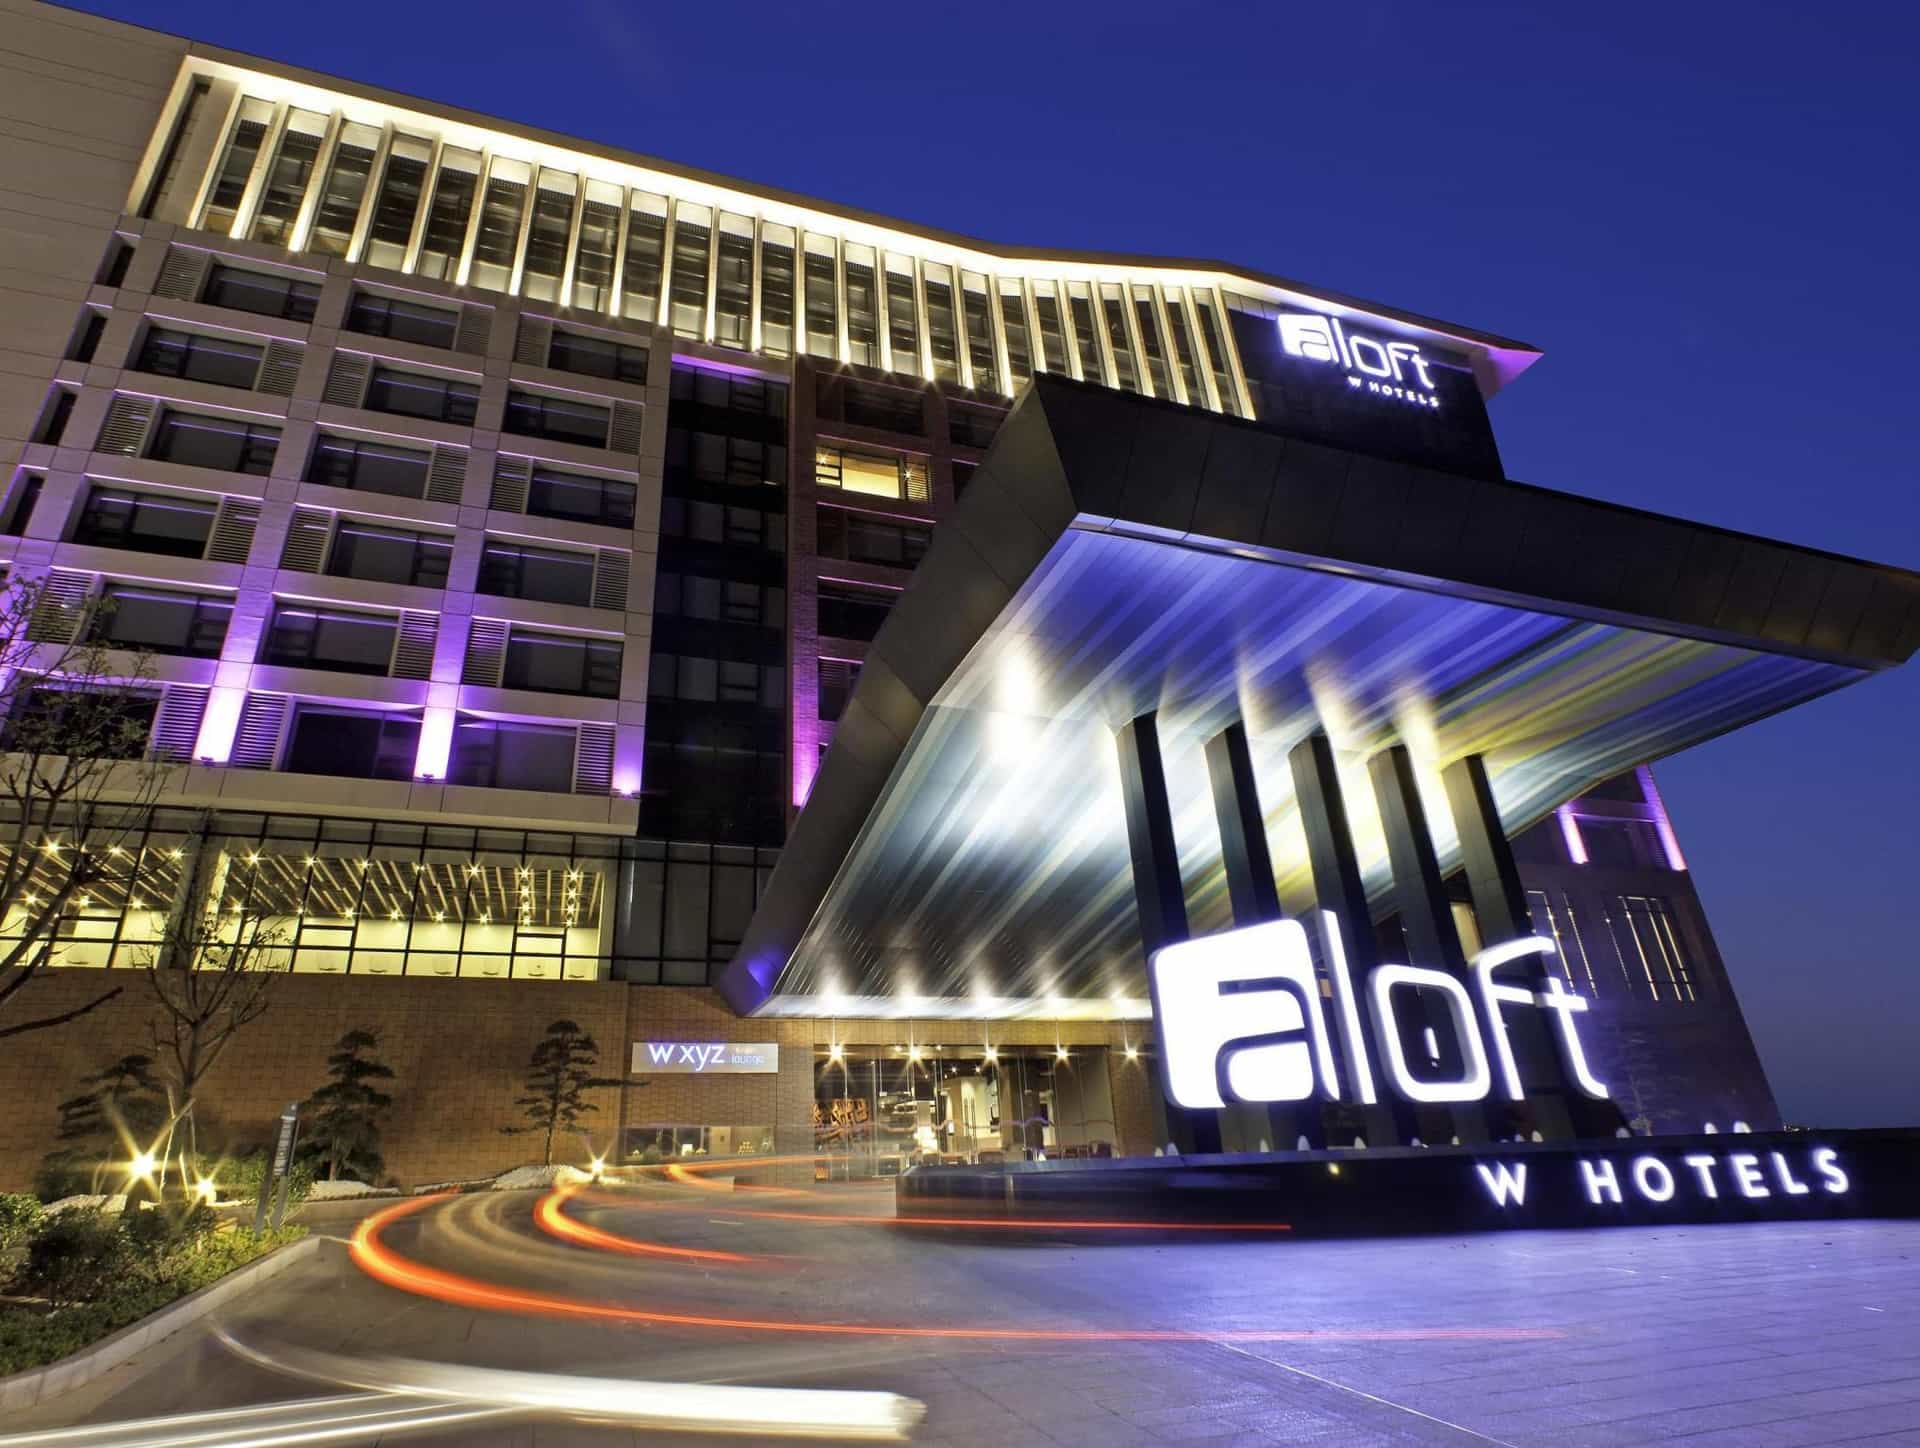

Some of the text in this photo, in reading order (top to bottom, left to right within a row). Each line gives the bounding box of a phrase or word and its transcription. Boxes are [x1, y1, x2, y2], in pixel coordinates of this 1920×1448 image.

[1277, 313, 1435, 389] aloft
[1347, 375, 1439, 407] W HOTELS
[1152, 909, 1609, 1109] aloft
[1476, 1148, 1850, 1207] W HOTELS
